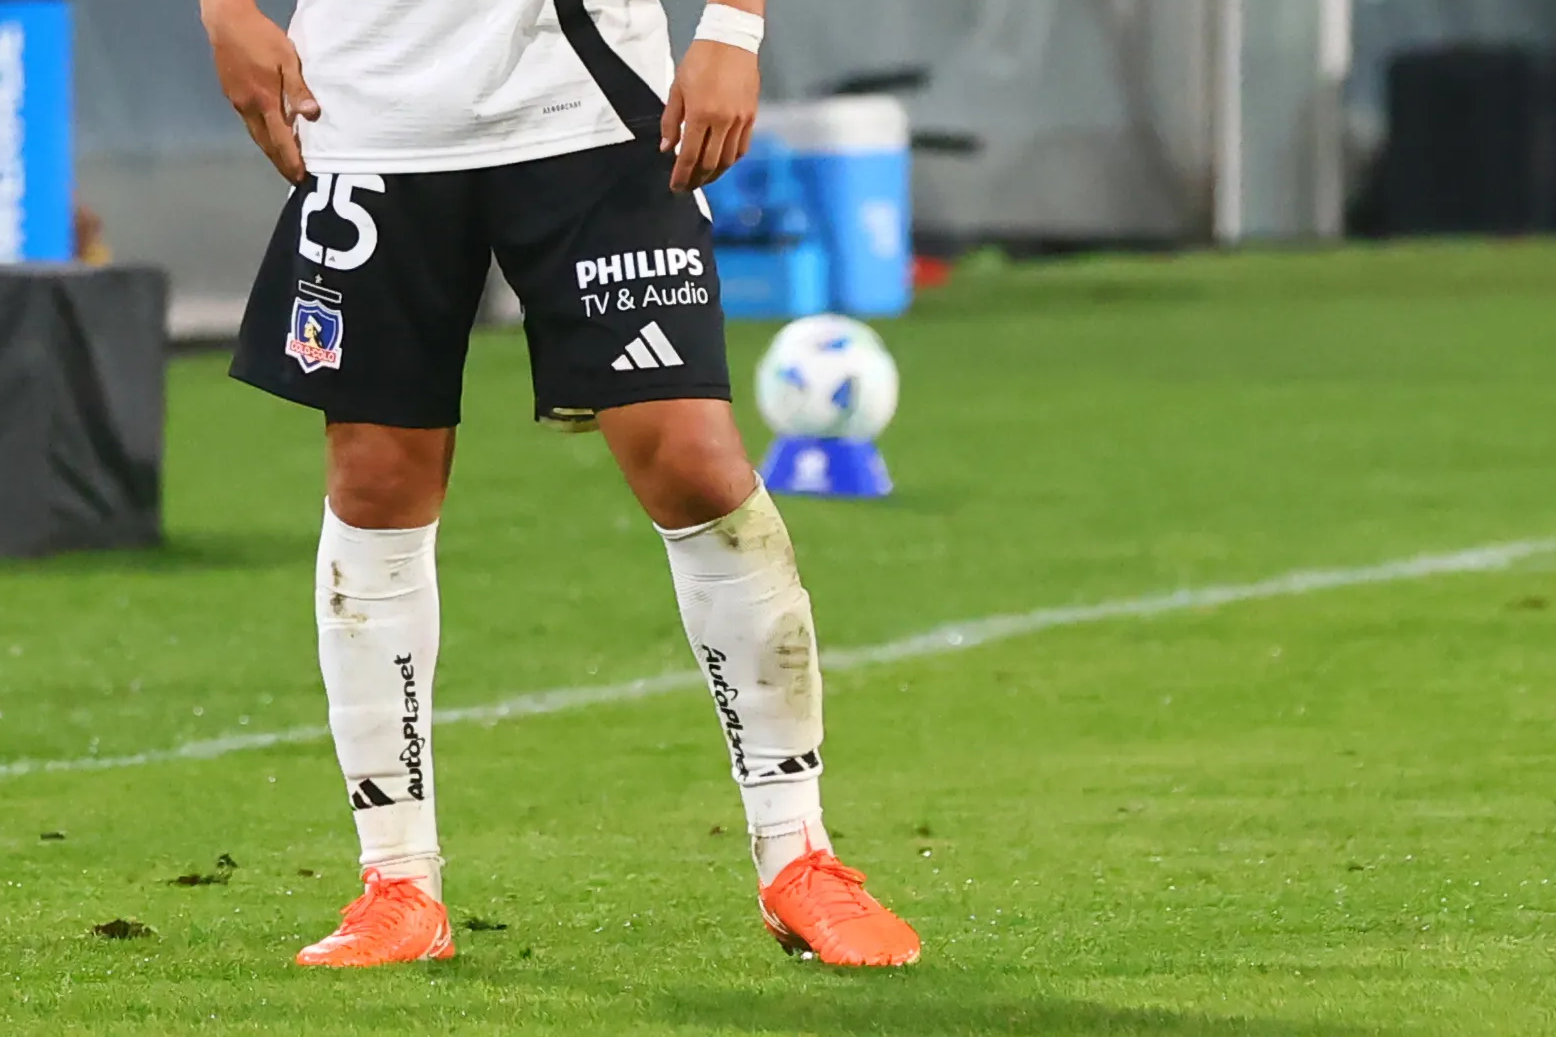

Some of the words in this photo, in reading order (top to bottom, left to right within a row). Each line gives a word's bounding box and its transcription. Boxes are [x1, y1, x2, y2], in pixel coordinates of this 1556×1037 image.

[299, 173, 386, 271] 25
[575, 247, 704, 289] PHILIPS
[580, 291, 610, 318] TV
[616, 288, 636, 311] &
[642, 280, 709, 308] Audio
[290, 339, 336, 363] COLO-COLO
